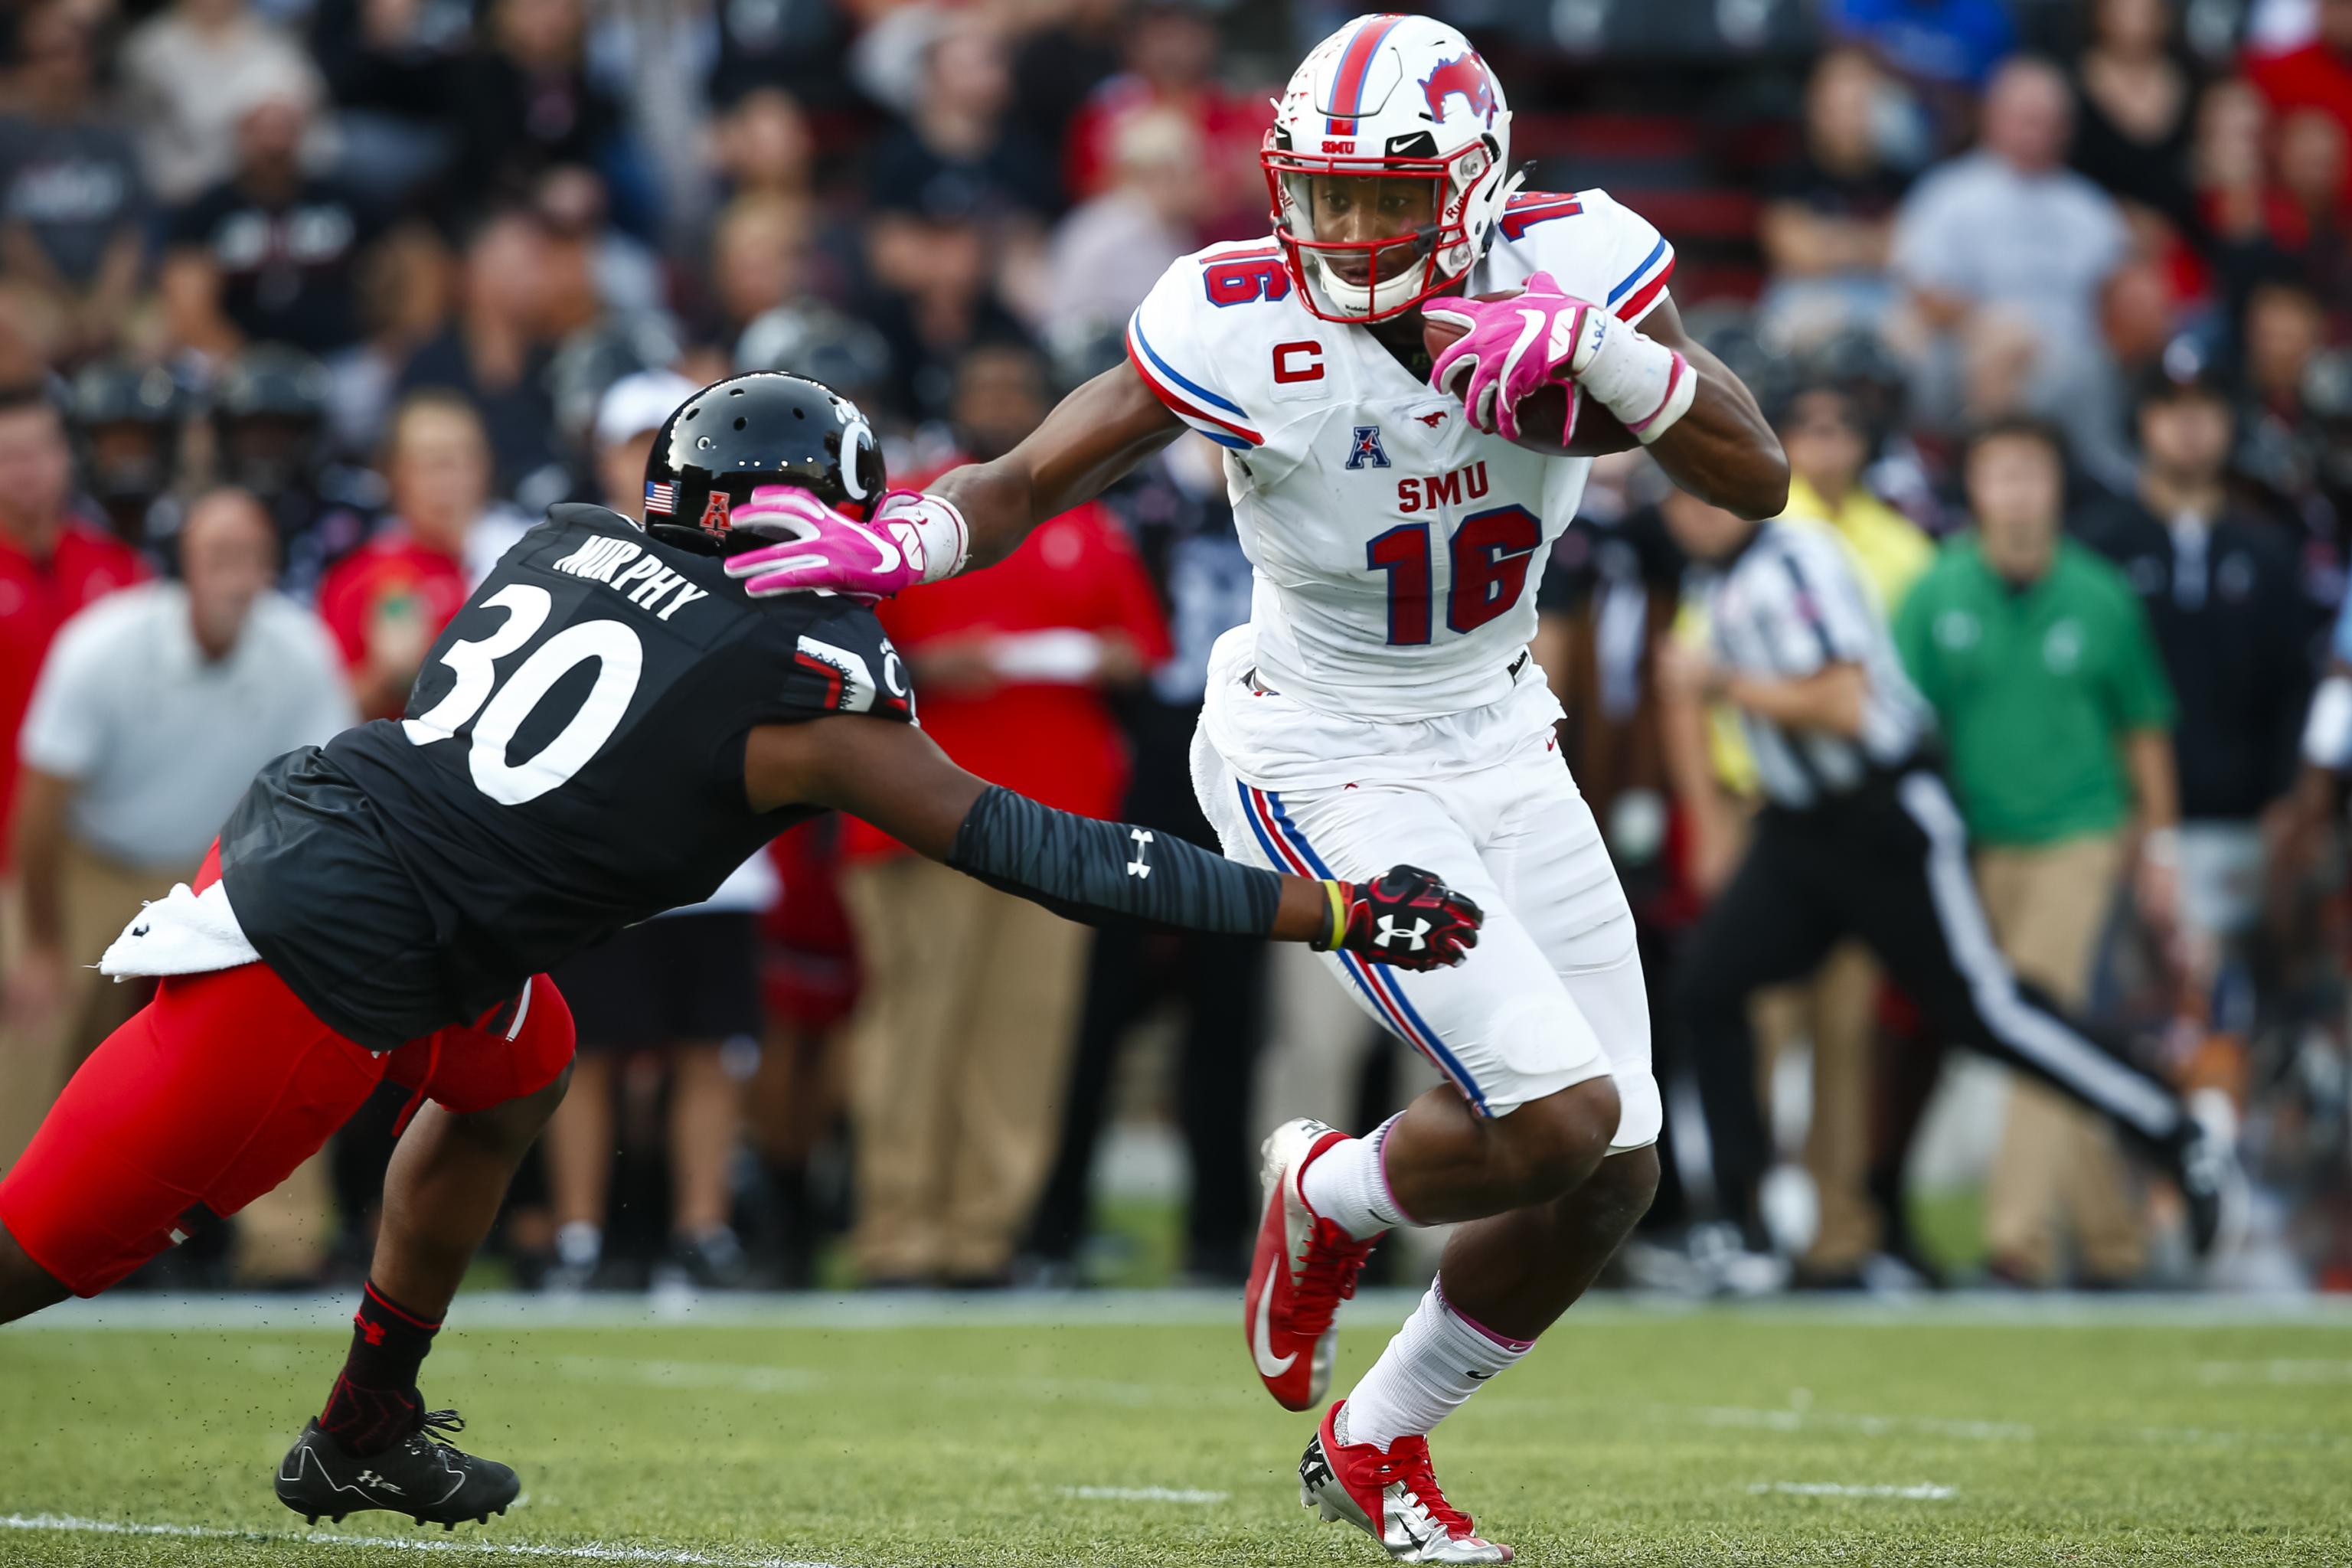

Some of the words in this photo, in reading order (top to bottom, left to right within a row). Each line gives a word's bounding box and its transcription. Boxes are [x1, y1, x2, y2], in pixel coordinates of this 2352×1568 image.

[1199, 247, 1292, 309] 16
[1272, 340, 1325, 384] C
[1345, 426, 1390, 470] A
[1398, 460, 1489, 514] SMU
[552, 534, 710, 622] MURPHY
[1366, 502, 1543, 645] 16
[401, 583, 644, 806] 30
